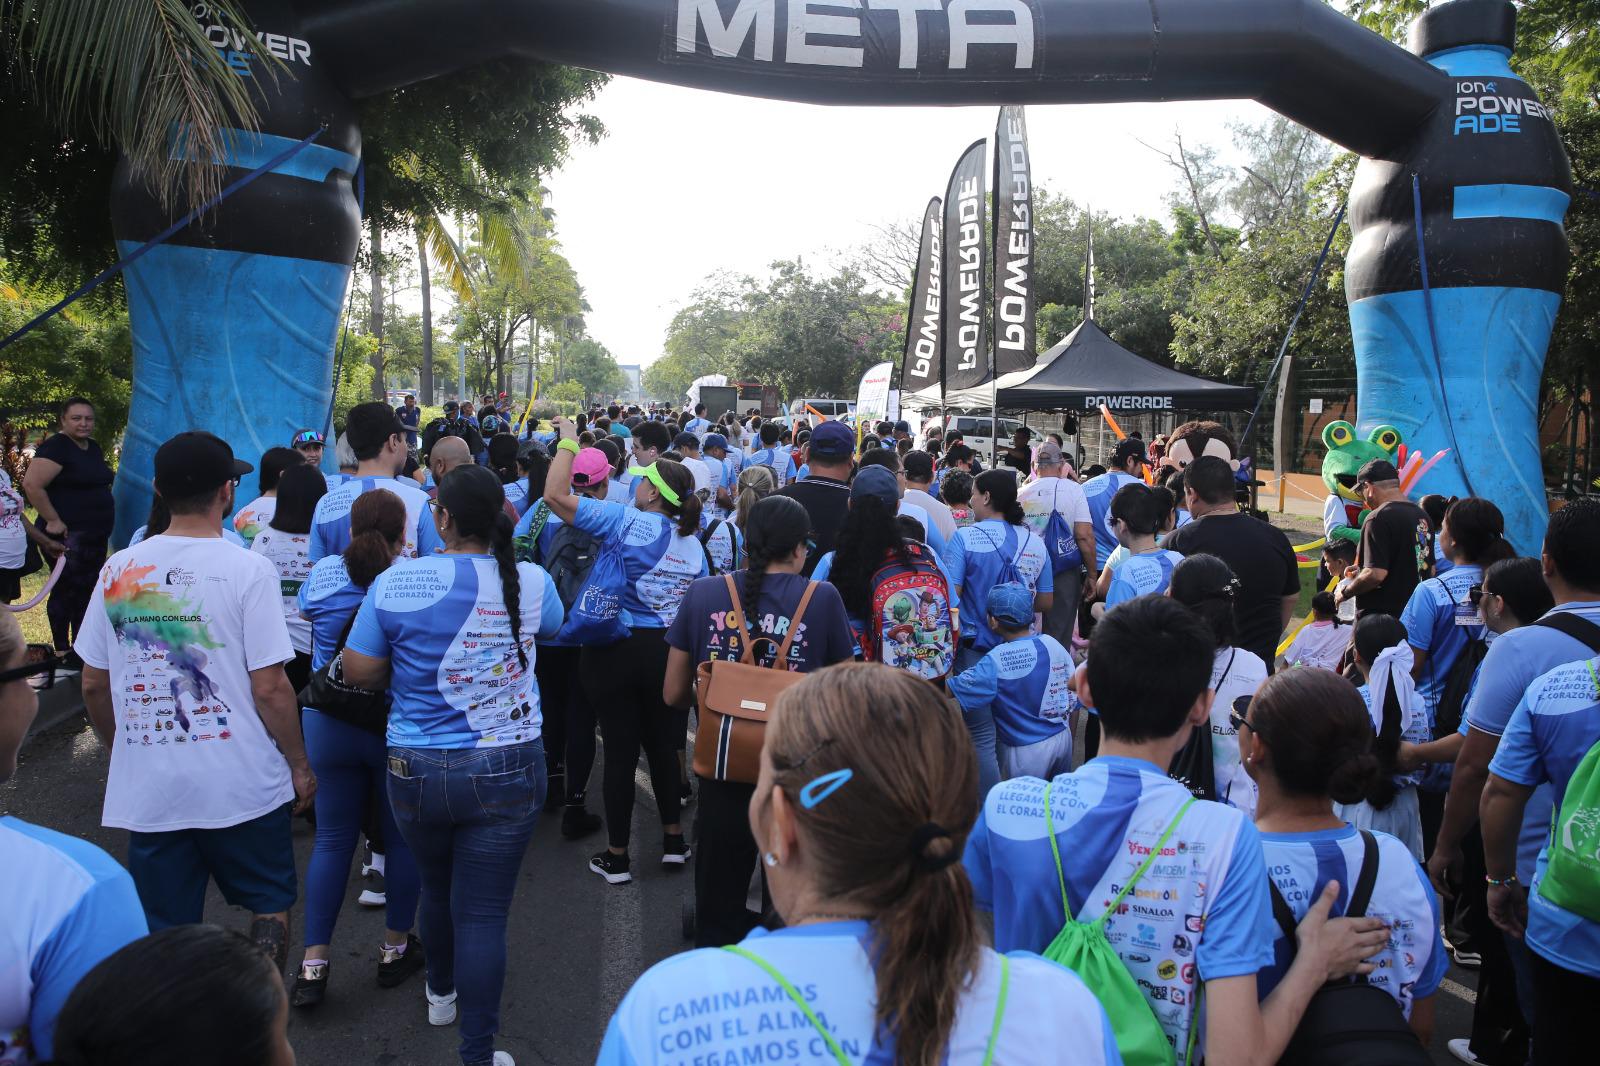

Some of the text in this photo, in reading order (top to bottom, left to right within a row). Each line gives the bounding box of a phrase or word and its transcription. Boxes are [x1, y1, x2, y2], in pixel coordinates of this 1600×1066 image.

[676, 0, 1034, 69] META
[198, 24, 312, 66] OWER
[1455, 96, 1550, 121] POWER
[1453, 114, 1521, 136] ADE
[1085, 396, 1173, 409] POWERADE
[394, 590, 435, 599] CORAZÓN
[428, 584, 448, 592] CON
[128, 616, 140, 624] LA
[140, 615, 161, 623] MANO
[710, 610, 754, 632] YO
[729, 636, 738, 648] B
[791, 645, 800, 657] E
[996, 803, 1007, 814] EL
[999, 791, 1089, 810] LLEGAMS CON
[1278, 878, 1298, 889] MA
[1132, 904, 1175, 917] SINALOA
[1137, 979, 1168, 995] POWER
[660, 1023, 712, 1054] CON
[722, 1018, 749, 1039] EL
